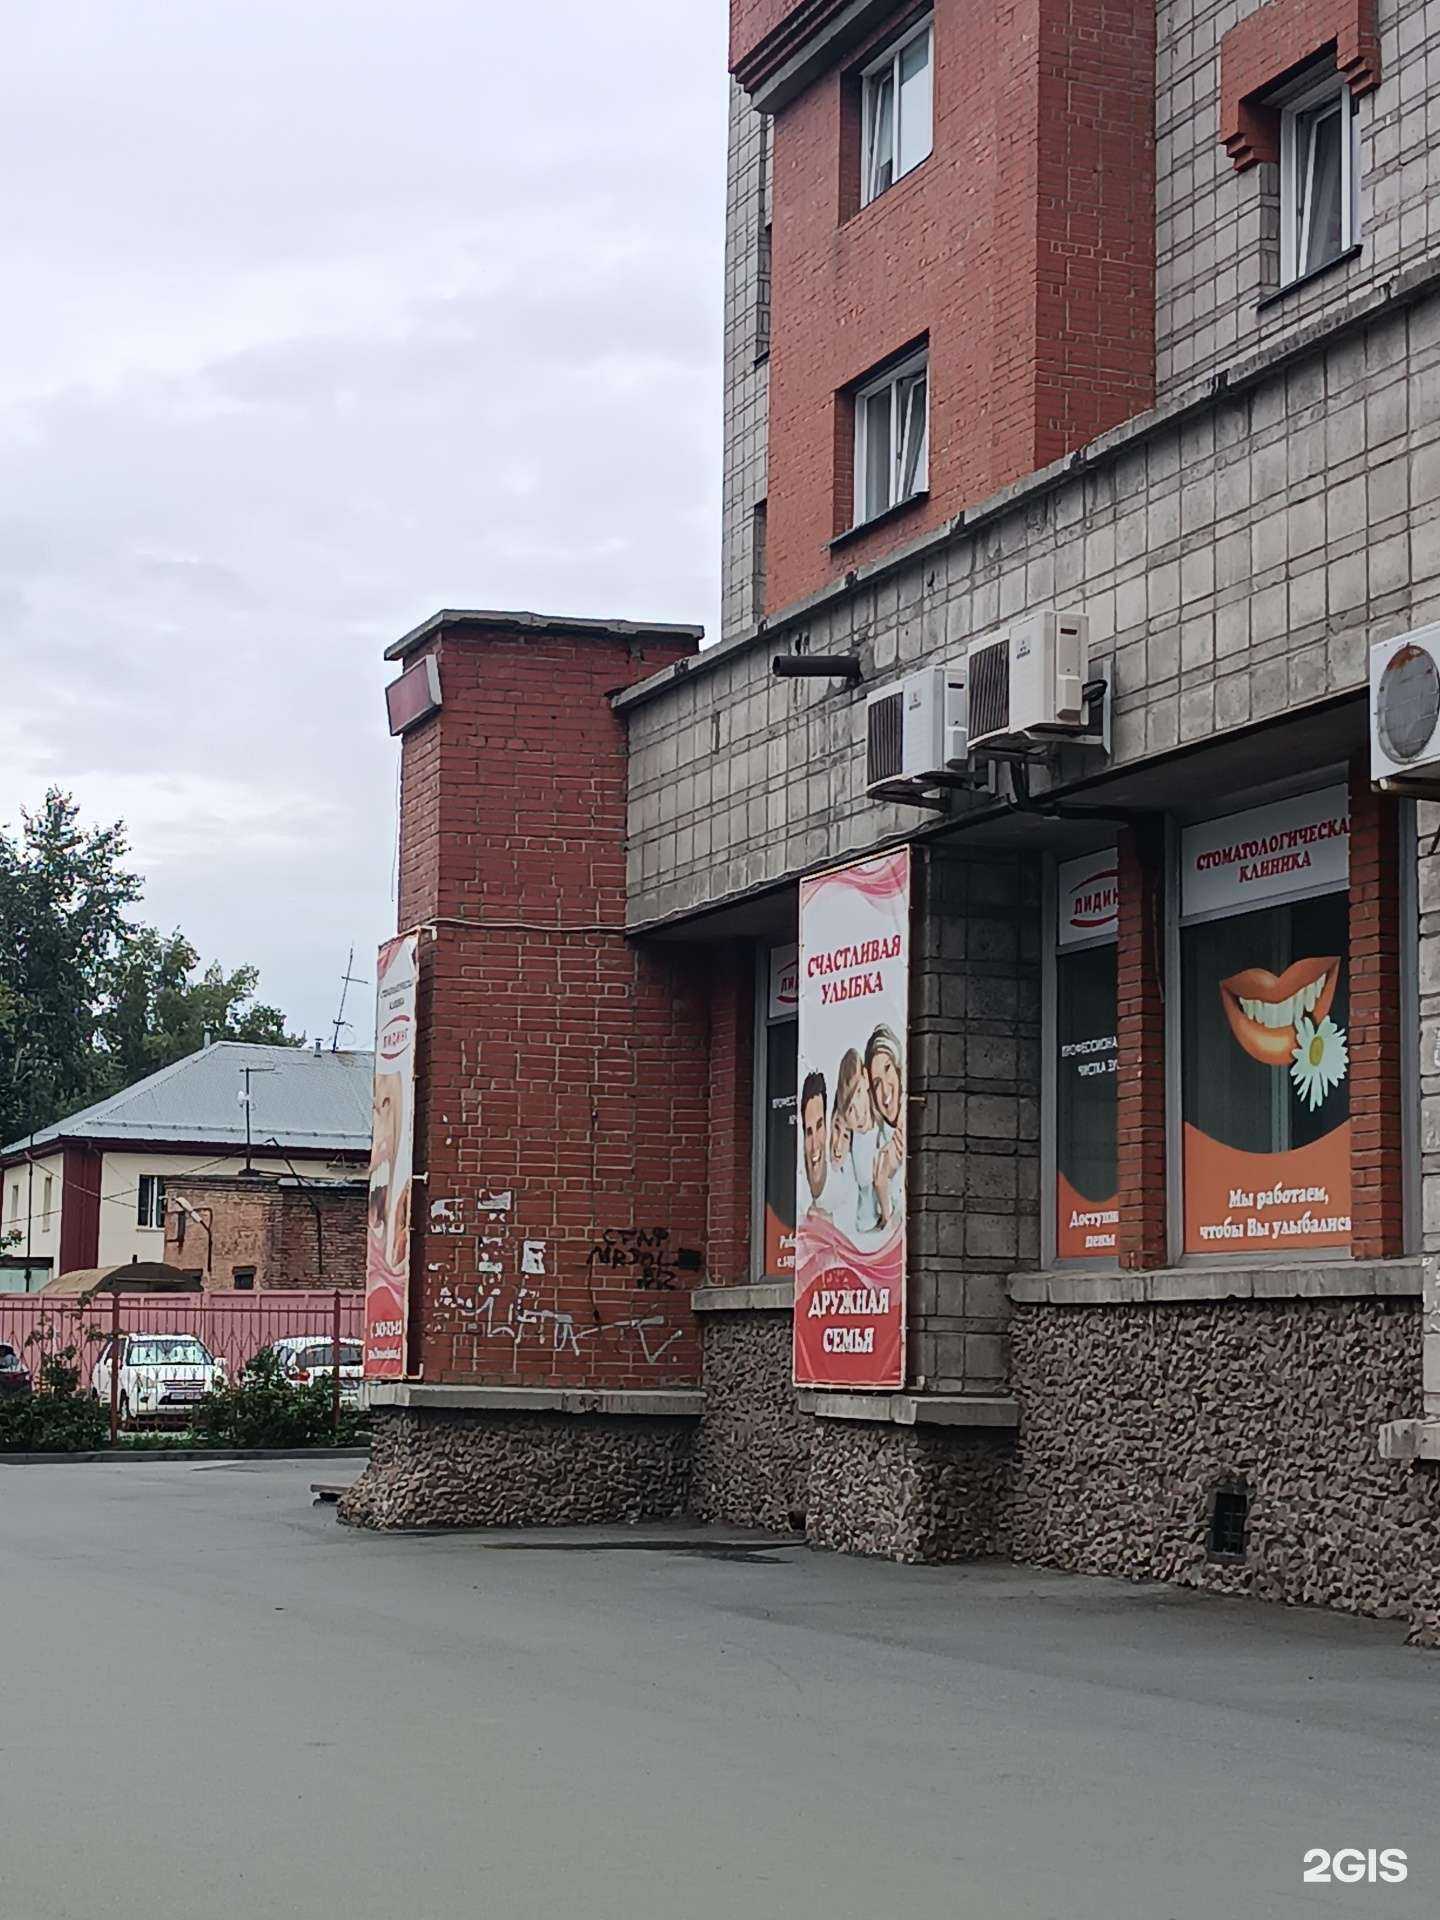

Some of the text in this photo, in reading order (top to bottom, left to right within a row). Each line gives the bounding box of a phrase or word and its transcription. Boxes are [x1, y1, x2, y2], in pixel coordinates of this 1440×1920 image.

[1195, 817, 1350, 870] СТОМАТОЛОГИЧЕСКА
[1238, 850, 1311, 883] КЛИНИКА
[808, 934, 901, 978] СЧАСТЛИВАЯ
[822, 971, 883, 1005] УЛЫБКА
[1229, 1181, 1329, 1210] Мы работаем,
[1200, 1216, 1244, 1239] чтобы
[1247, 1218, 1269, 1237] Вы
[808, 1288, 890, 1319] ДРУЖНАЯ
[823, 1327, 875, 1353] СЕМЬЯ
